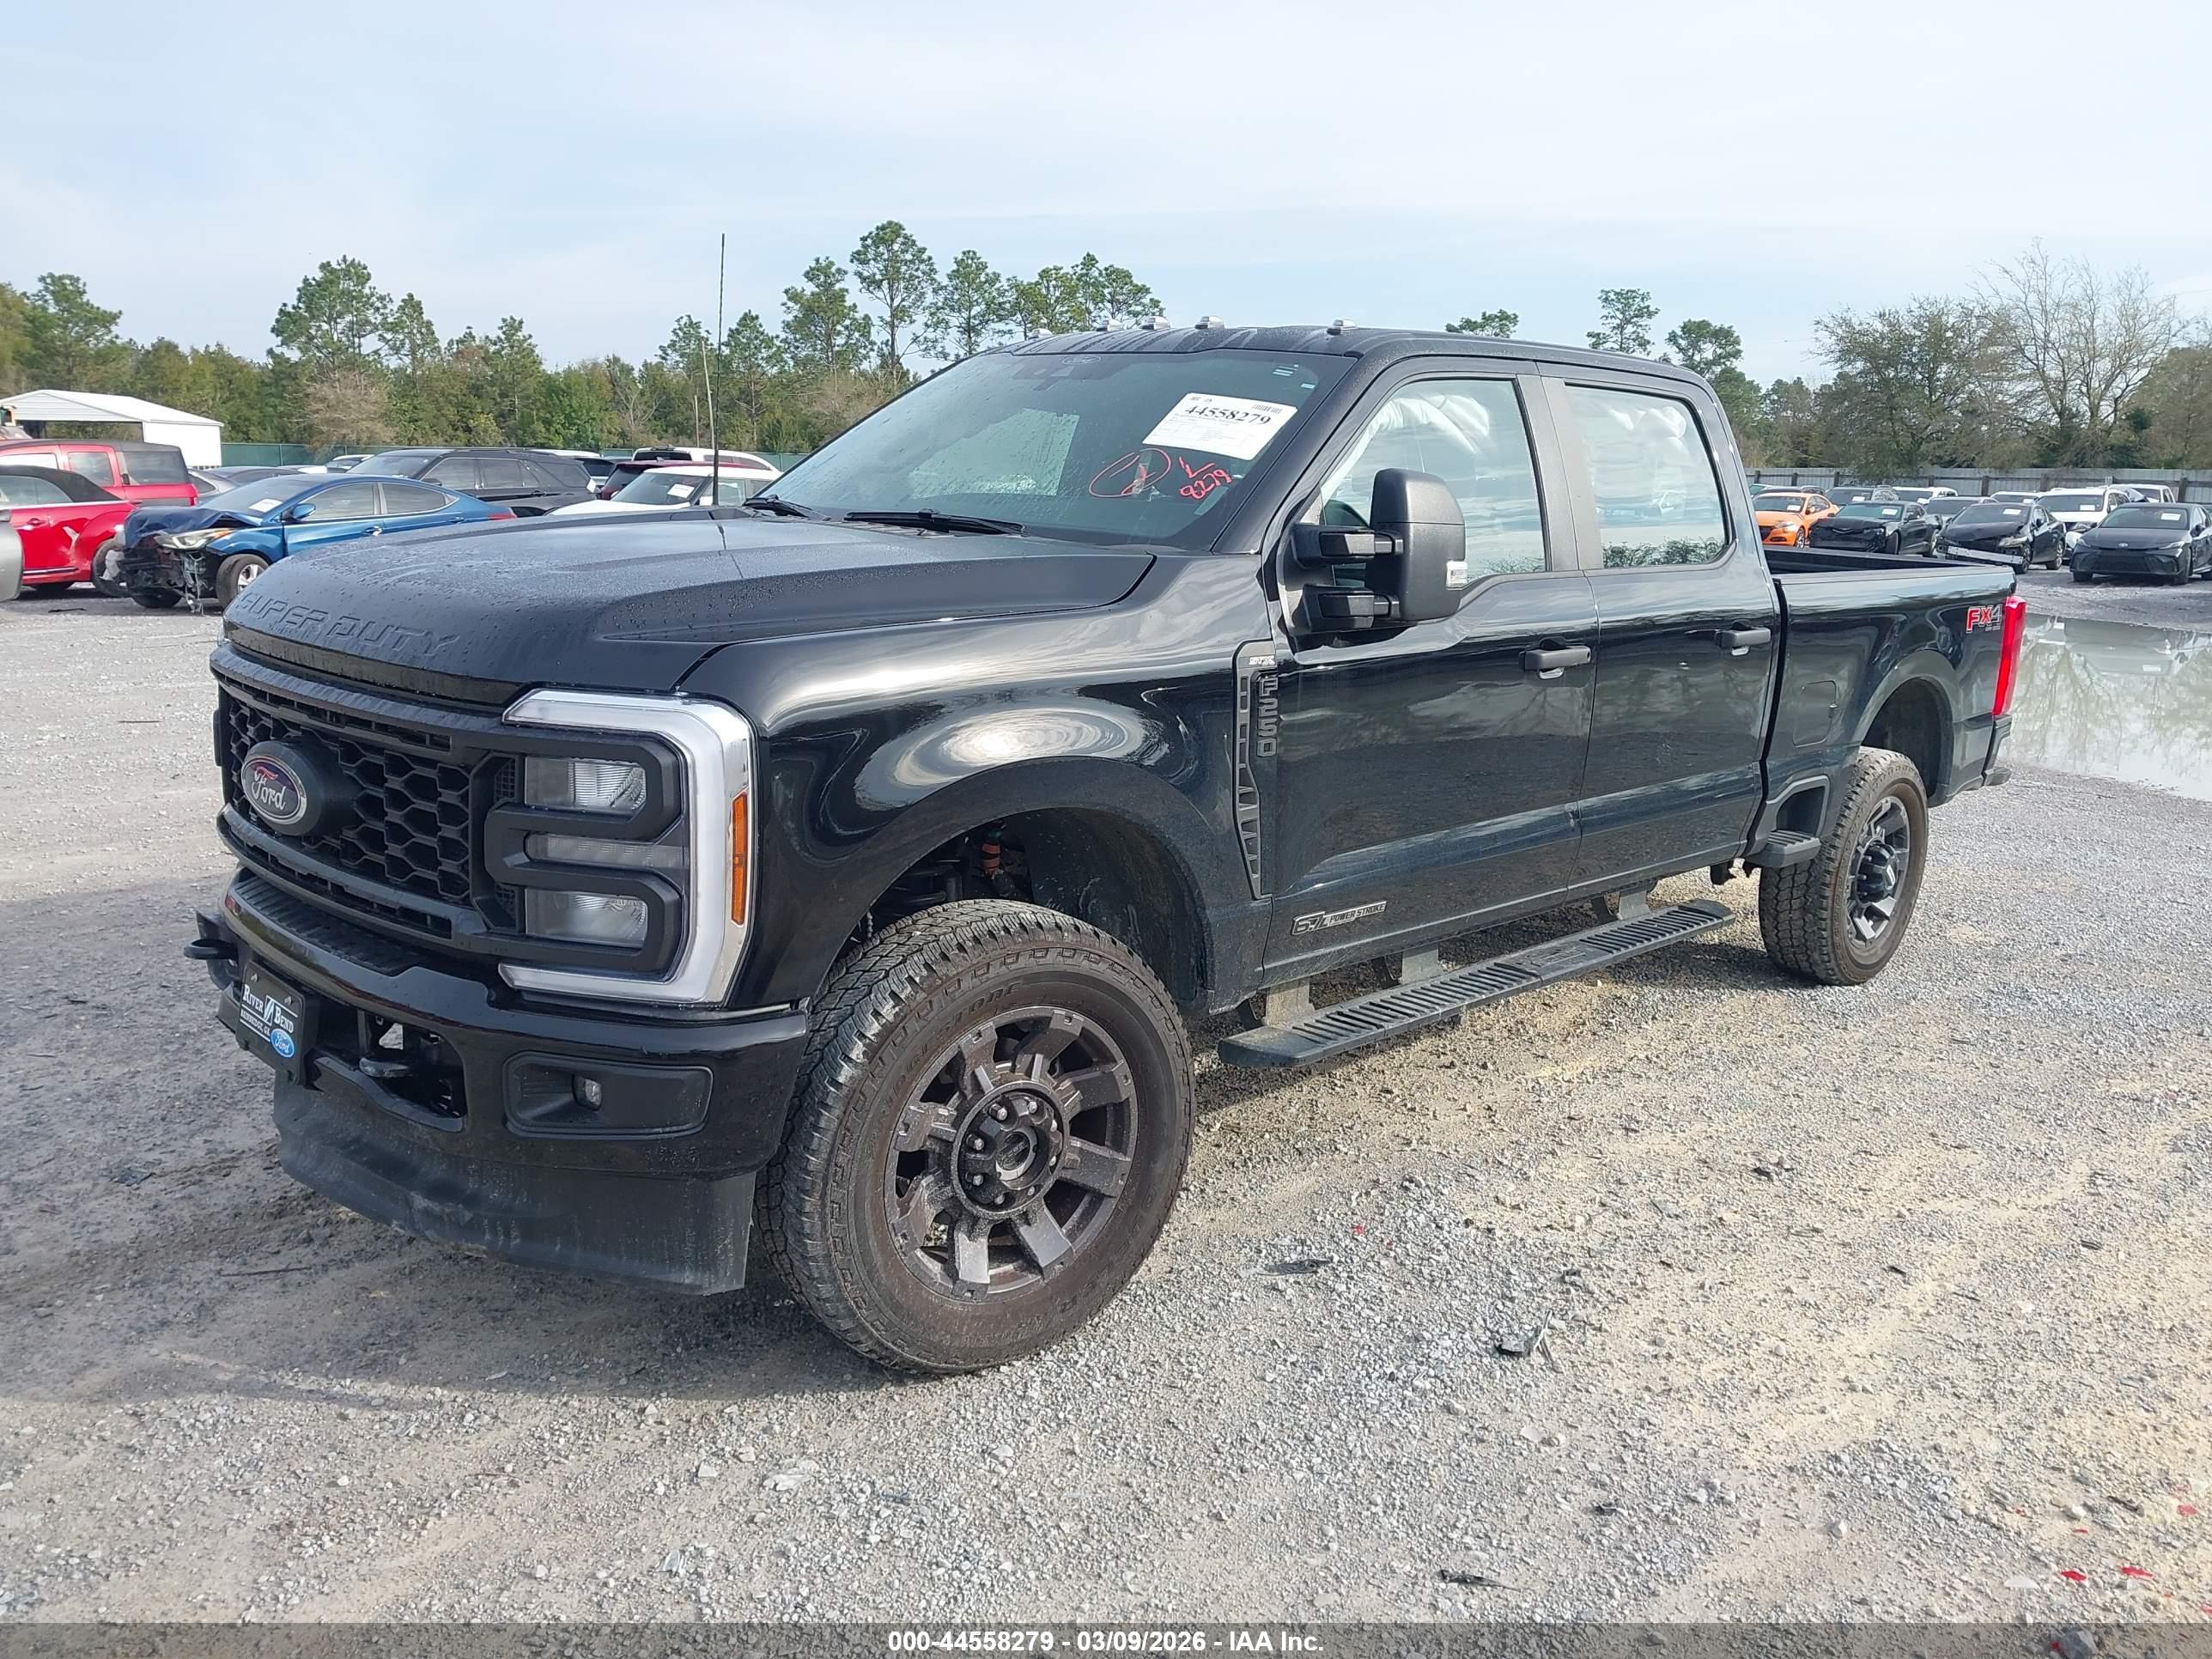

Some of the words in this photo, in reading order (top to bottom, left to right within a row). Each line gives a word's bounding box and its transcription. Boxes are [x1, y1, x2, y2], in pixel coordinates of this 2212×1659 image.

[1184, 404, 1272, 425] 44558279
[1179, 469, 1232, 499] 8279
[234, 592, 330, 630] SUPER
[325, 614, 461, 657] DUTY
[1966, 604, 2003, 634] FX4
[1249, 655, 1276, 666] STX
[1256, 675, 1279, 757] F250
[251, 766, 288, 811] Ford
[1329, 910, 1357, 926] POWER
[1356, 902, 1387, 921] STROKE
[274, 1030, 291, 1054] Ford
